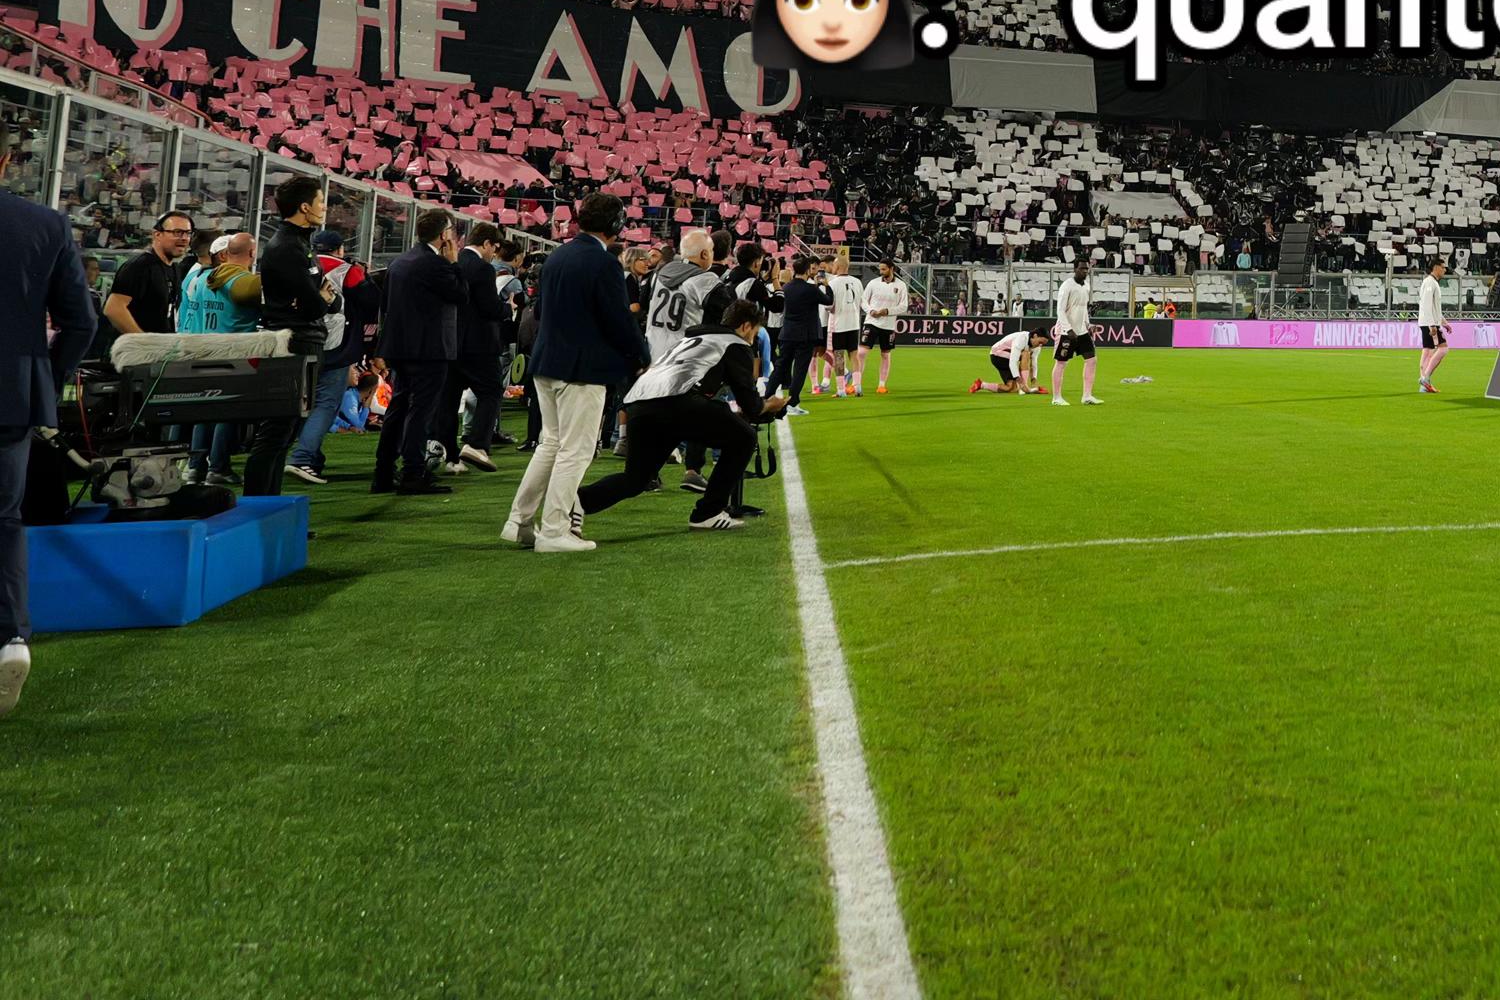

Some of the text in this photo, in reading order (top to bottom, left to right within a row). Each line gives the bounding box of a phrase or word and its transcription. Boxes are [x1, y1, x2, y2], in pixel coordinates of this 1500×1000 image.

[526, 9, 801, 120] AMO
[651, 287, 687, 332] 29
[204, 312, 218, 331] 10
[895, 318, 1005, 336] OLET SPOSI
[914, 336, 968, 345] coletsposi.com
[1313, 321, 1404, 347] ANNIVERSARY
